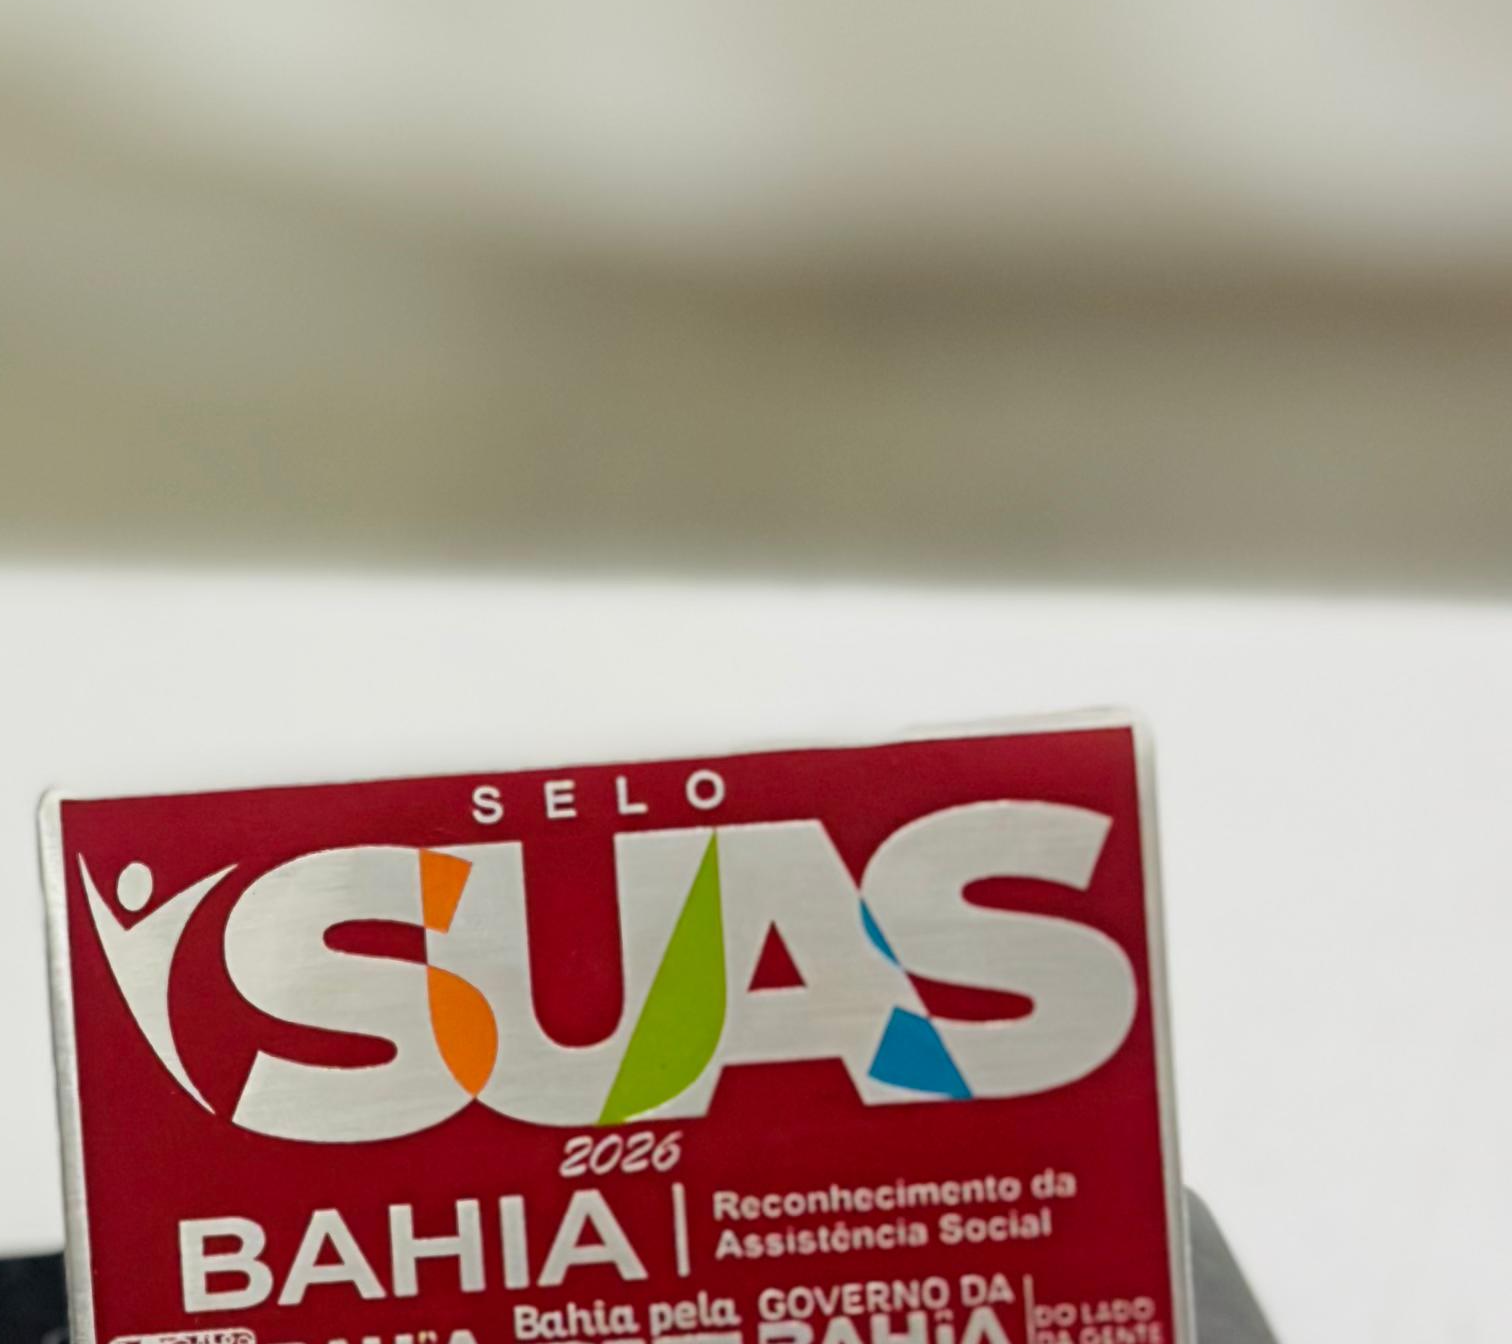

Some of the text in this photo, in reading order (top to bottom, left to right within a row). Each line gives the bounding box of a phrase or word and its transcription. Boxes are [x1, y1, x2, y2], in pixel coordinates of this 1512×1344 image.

[472, 770, 725, 824] SELO
[225, 799, 1137, 1142] SUAS
[559, 1130, 683, 1178] 2026
[713, 1168, 1077, 1221] Reconhecimento da
[178, 1189, 648, 1313] BAHIA
[715, 1207, 1052, 1260] Assistência Social
[513, 1290, 742, 1340] Bahia pela
[758, 1272, 1015, 1321] GOVERNO DA
[1034, 1295, 1156, 1329] DO LADO
